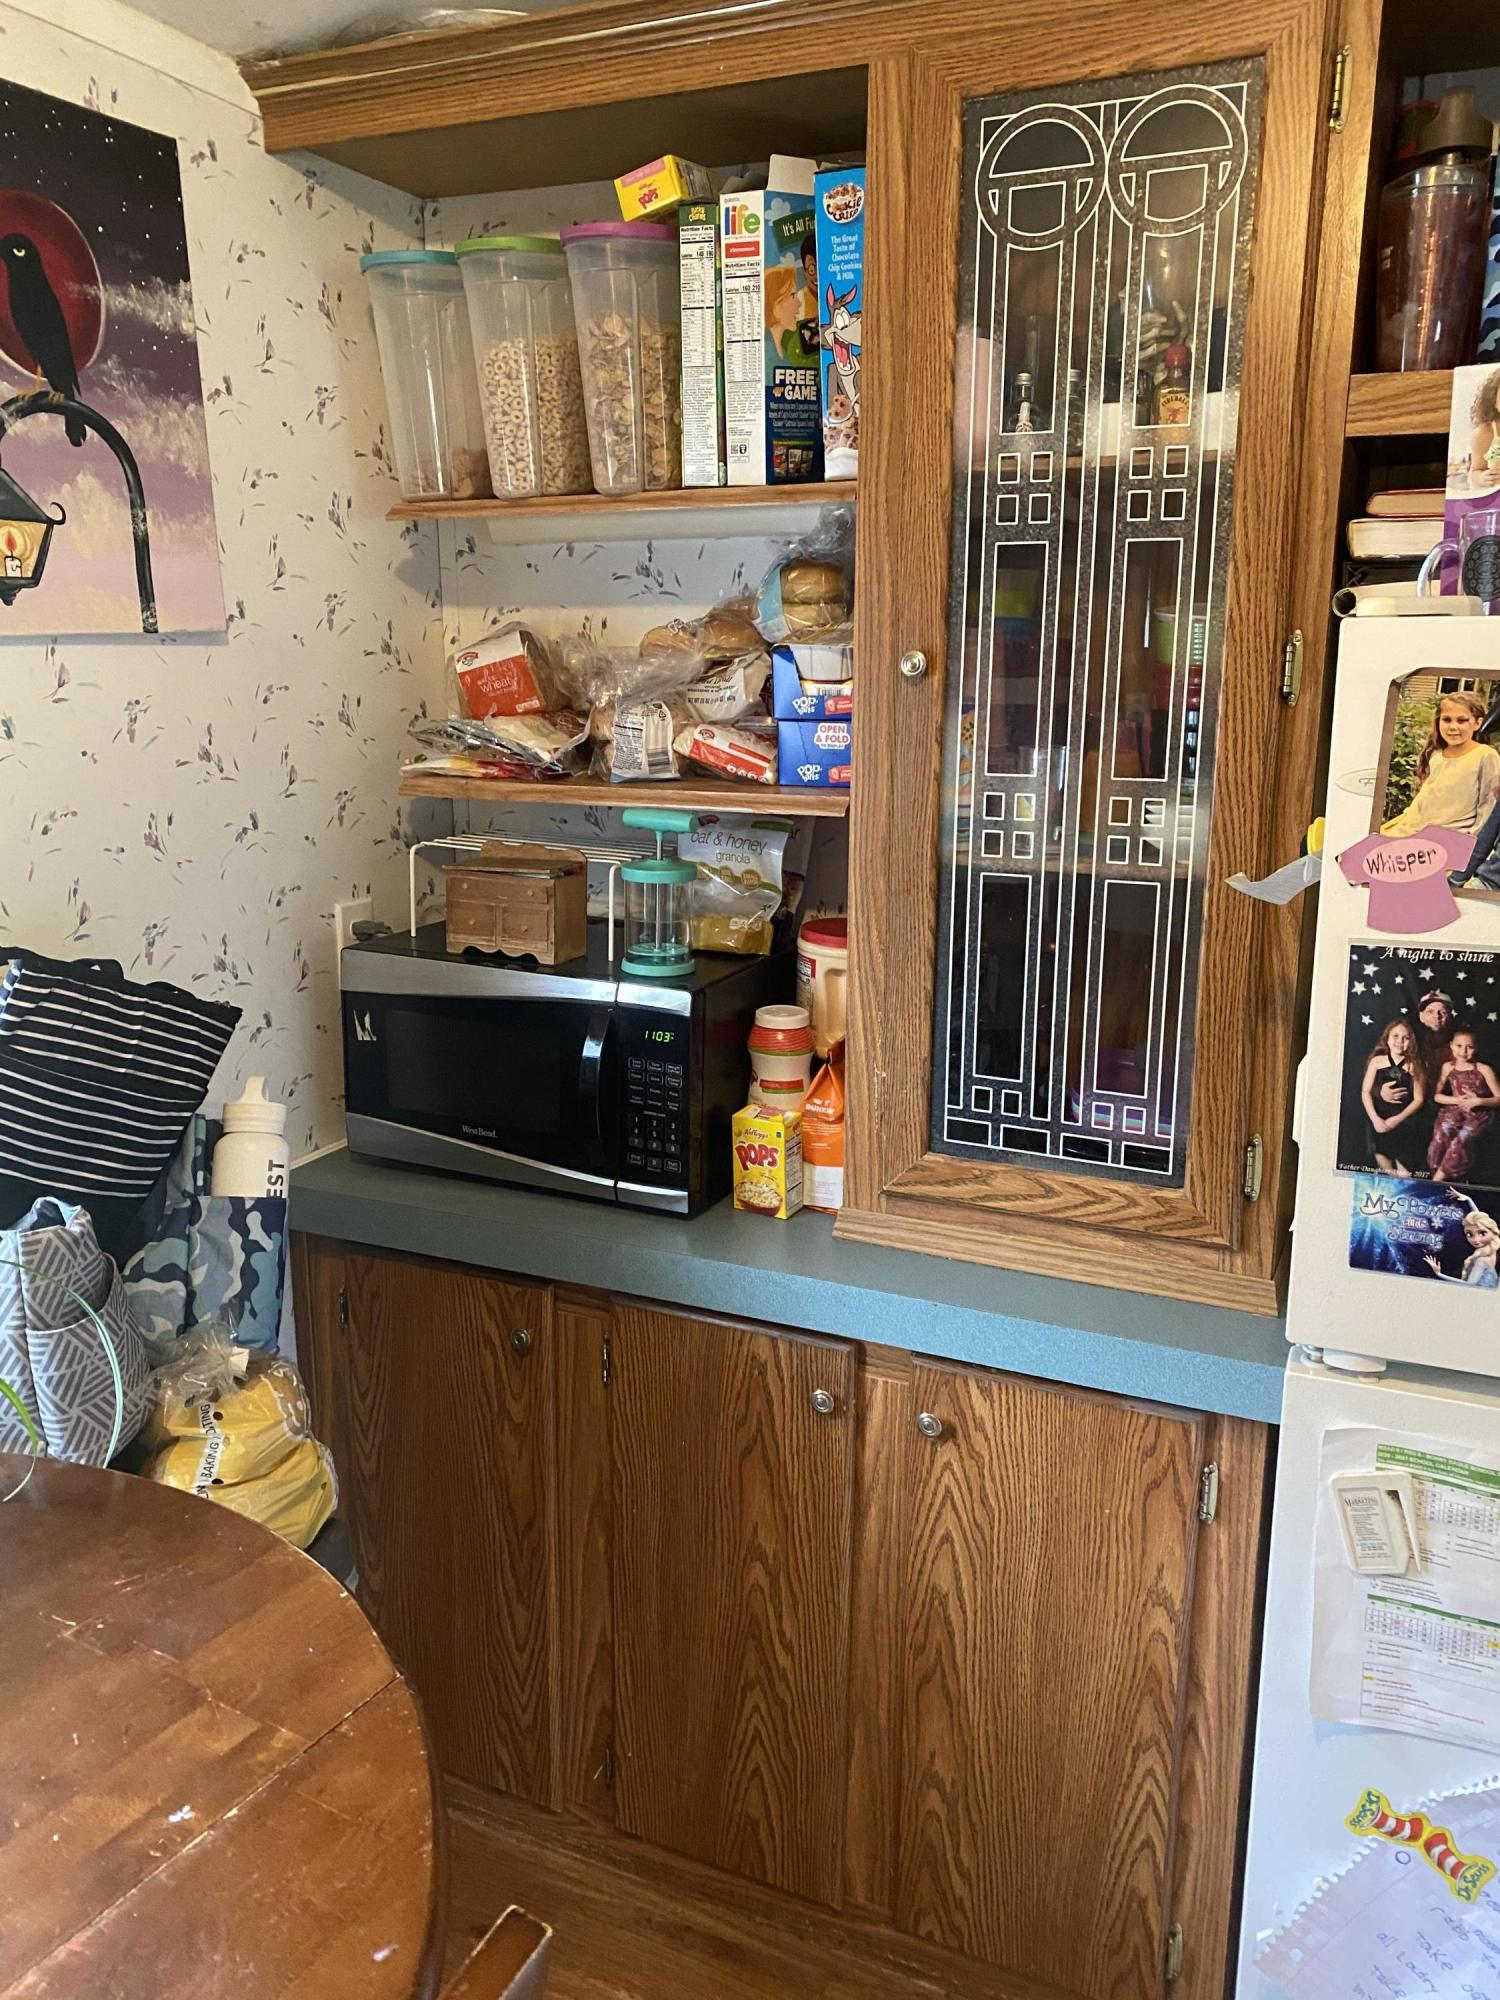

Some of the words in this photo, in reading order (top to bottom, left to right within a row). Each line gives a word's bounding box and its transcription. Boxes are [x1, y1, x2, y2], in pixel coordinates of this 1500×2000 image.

[724, 204, 761, 236] life
[782, 222, 795, 237] It's
[795, 219, 805, 233] All
[831, 235, 842, 244] The
[842, 234, 858, 242] Great
[833, 244, 848, 253] Taste
[848, 242, 856, 250] of
[832, 252, 860, 262] Chocolate
[828, 264, 839, 272] Chip
[841, 262, 862, 270] Cookies
[842, 272, 854, 280] Milk
[775, 368, 815, 385] FREE
[784, 384, 817, 400] GAME
[480, 676, 513, 693] wheat
[820, 725, 846, 734] OPEN
[815, 735, 822, 743] &
[825, 734, 849, 744] FOLD
[690, 831, 712, 844] oat
[712, 832, 724, 846] &
[726, 834, 768, 856] honey
[716, 851, 751, 864] granola
[1366, 848, 1437, 875] Whisper
[1380, 946, 1394, 960] A
[1398, 947, 1435, 964] night
[1439, 949, 1454, 961] to
[1456, 950, 1495, 963] shine
[735, 1143, 779, 1172] POPS
[1360, 1192, 1400, 1220] My
[1396, 1195, 1464, 1220] Powers
[202, 1442, 220, 1479] BAKING
